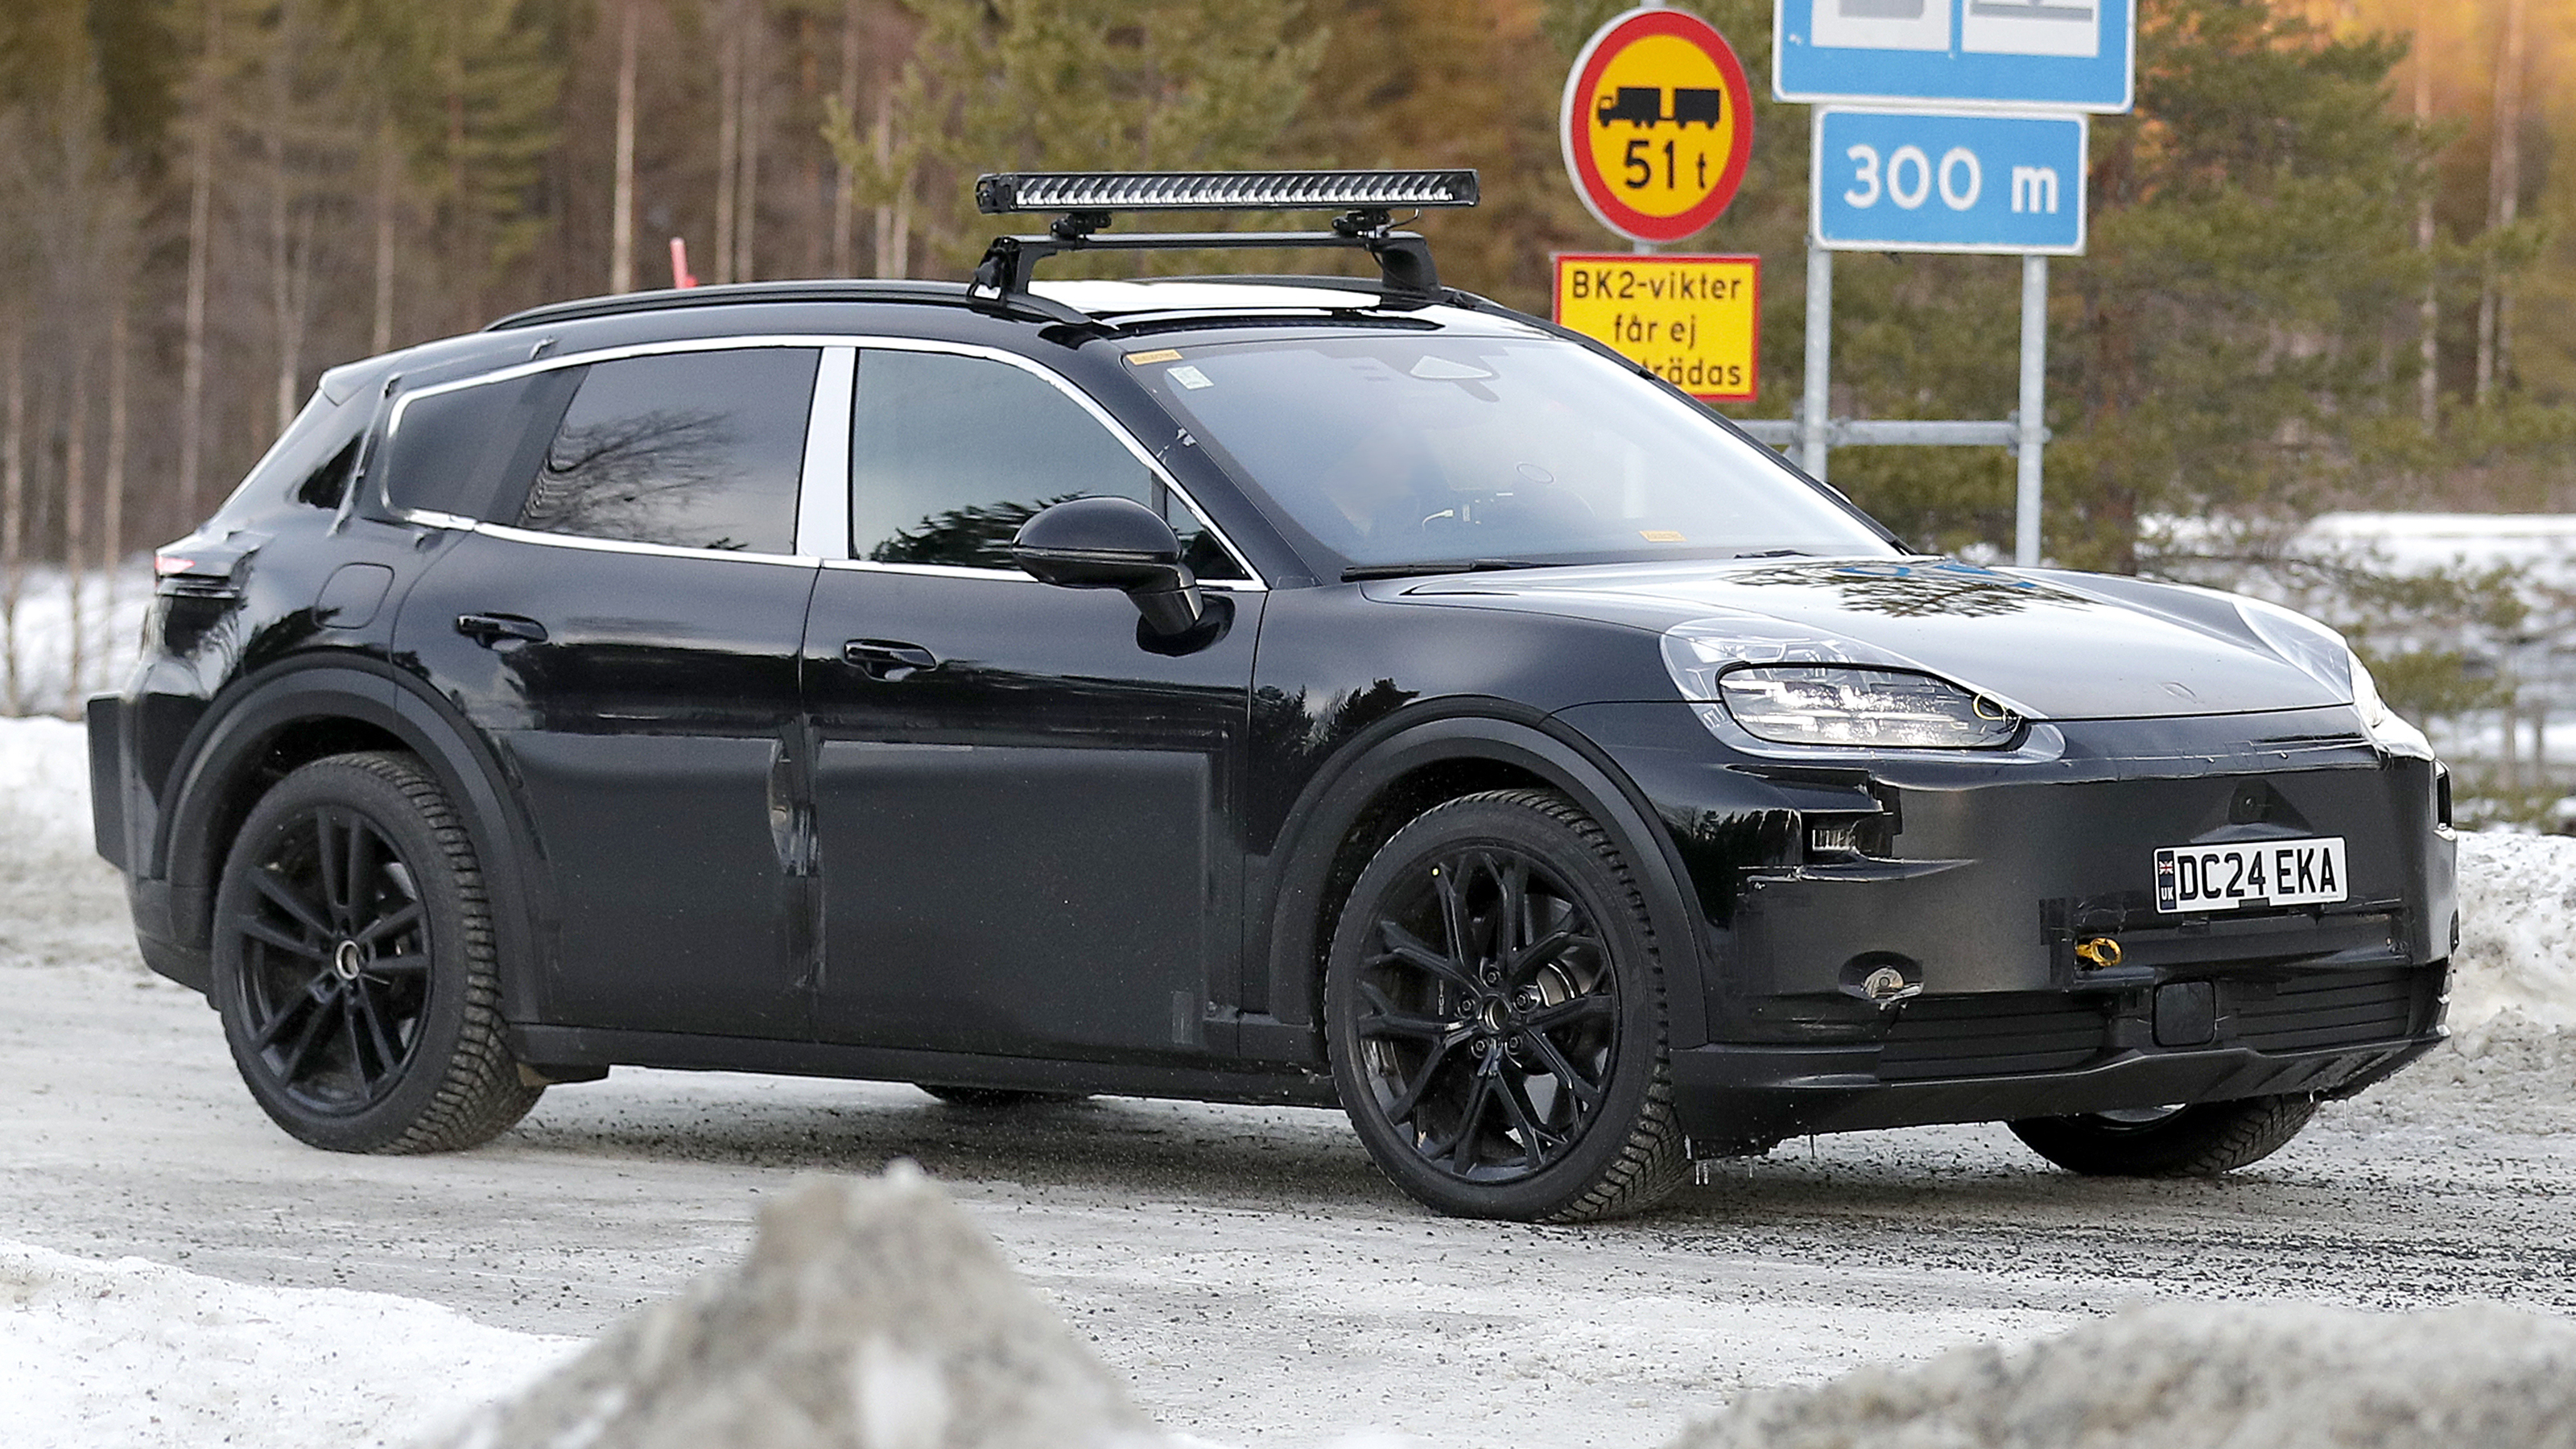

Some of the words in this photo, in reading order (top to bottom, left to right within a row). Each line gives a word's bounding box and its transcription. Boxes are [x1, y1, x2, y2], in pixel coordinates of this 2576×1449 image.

[1624, 140, 1675, 190] 51
[1696, 153, 1707, 189] t
[1844, 144, 1982, 212] 300
[2011, 166, 2059, 214] m
[1572, 270, 1742, 300] BK2-vikter
[1614, 313, 1658, 344] får
[1670, 315, 1696, 349] ej
[2161, 886, 2174, 901] UK
[2178, 850, 2266, 901] DC24
[2276, 848, 2337, 894] EKA
